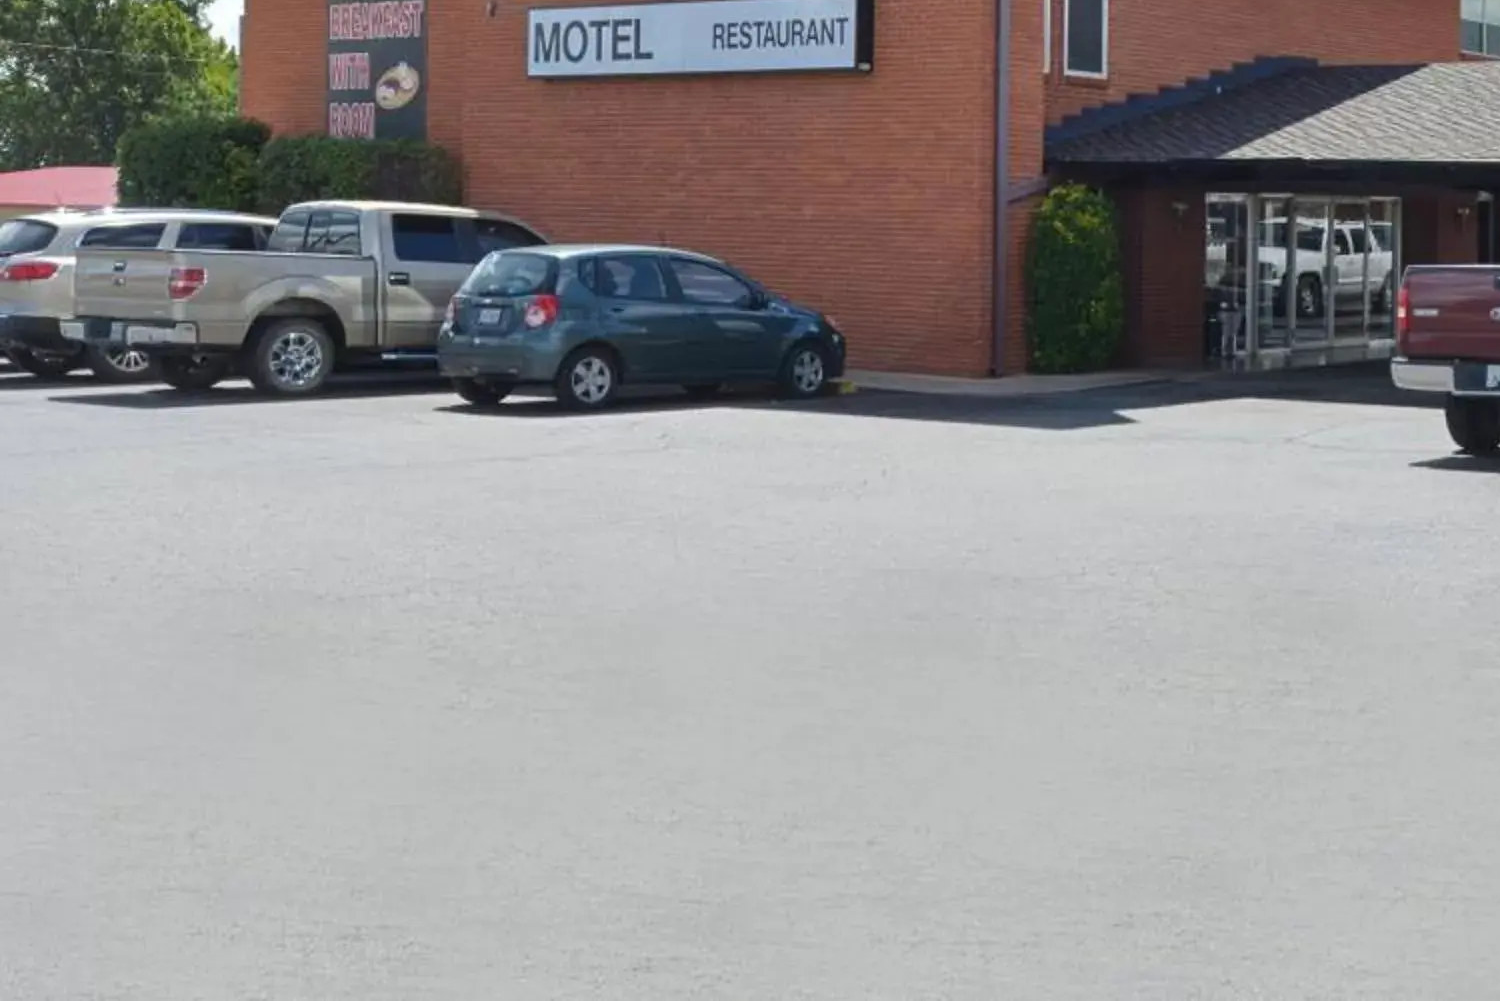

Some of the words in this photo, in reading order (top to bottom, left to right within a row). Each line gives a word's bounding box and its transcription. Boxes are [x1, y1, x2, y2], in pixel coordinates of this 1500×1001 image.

[329, 0, 424, 40] BREAKFAST
[533, 18, 654, 63] MOTEL
[712, 17, 849, 50] RESTAURANT
[328, 52, 370, 90] WITH
[329, 102, 376, 139] ROOM
